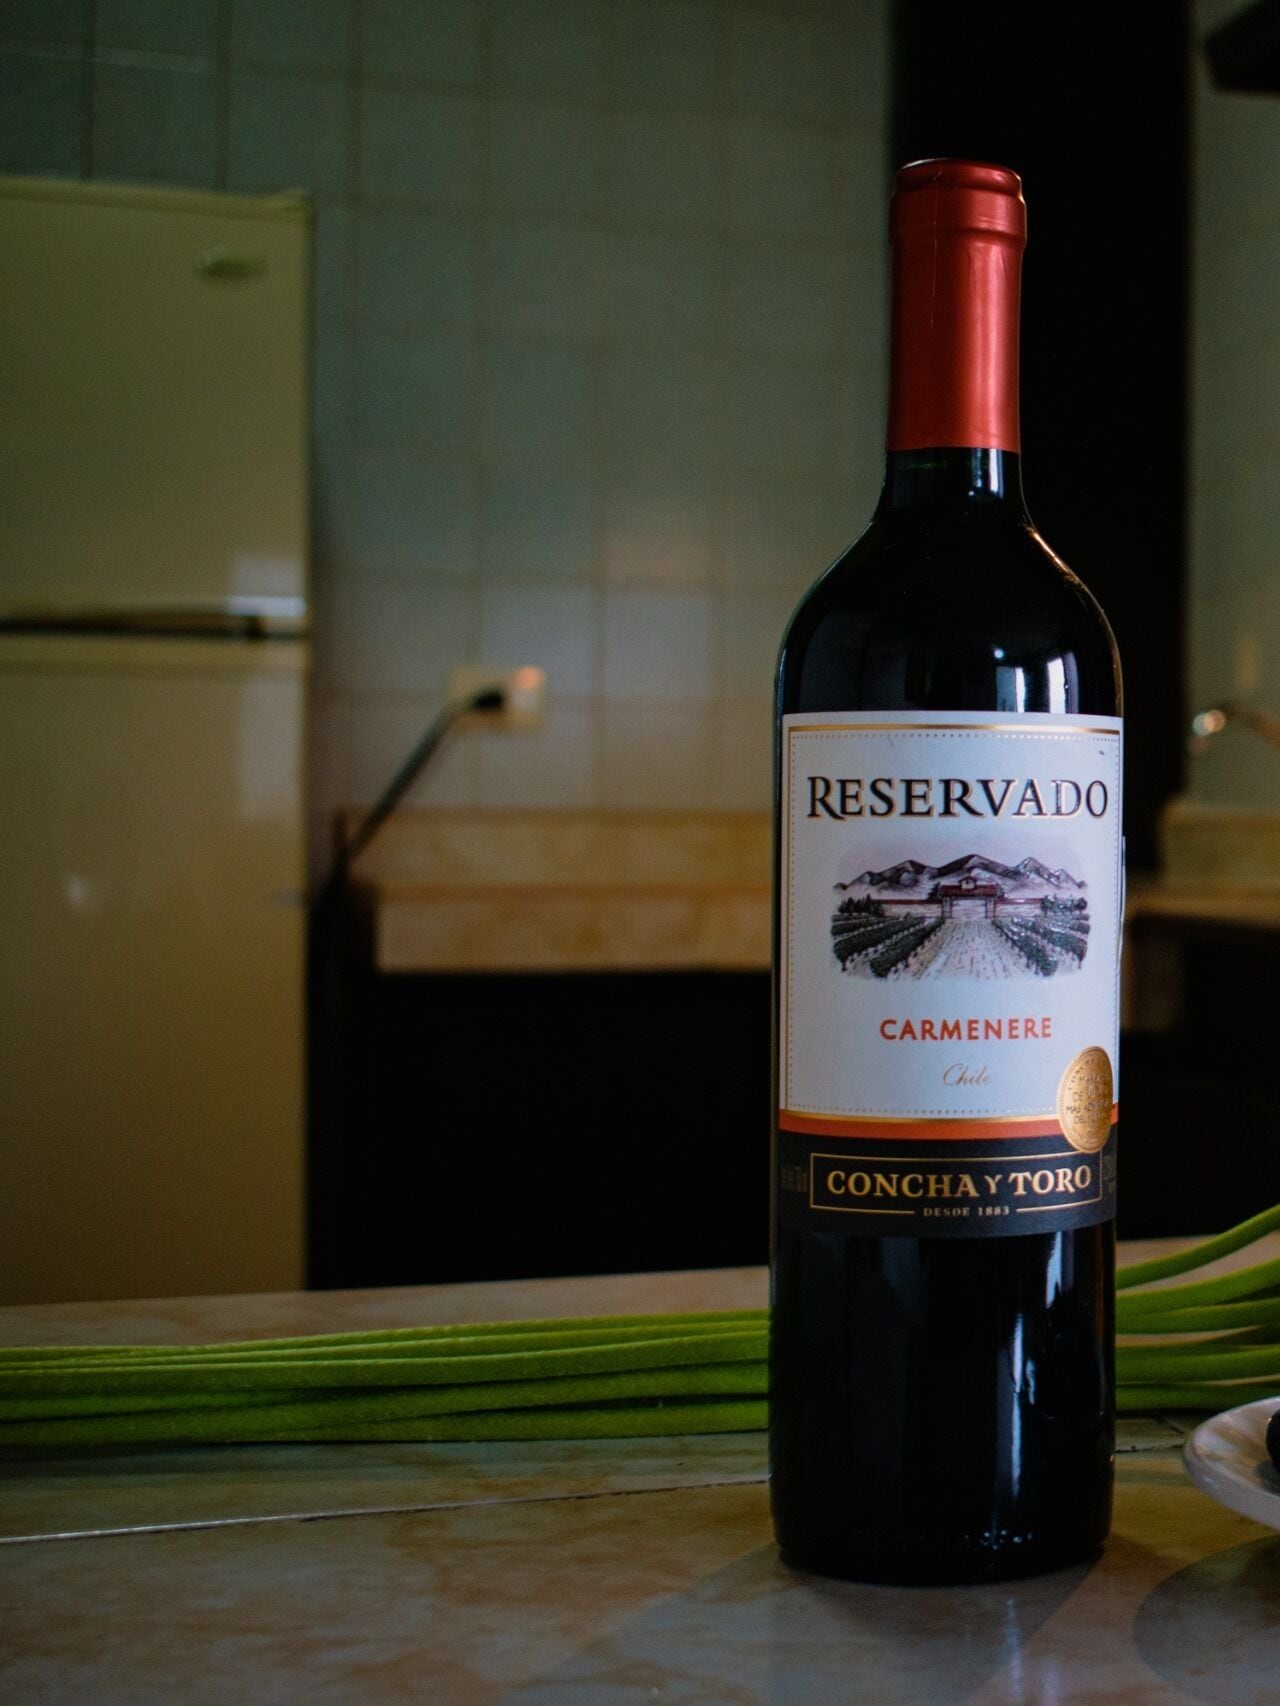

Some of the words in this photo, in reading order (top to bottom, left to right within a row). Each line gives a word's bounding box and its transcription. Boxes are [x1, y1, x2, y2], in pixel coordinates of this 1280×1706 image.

[807, 776, 1109, 821] RESERVADO
[880, 1018, 1052, 1041] CARMENERE
[942, 1063, 992, 1087] Chile
[827, 1170, 980, 1198] CONCHA
[984, 1175, 1003, 1195] Y
[1008, 1165, 1092, 1195] TORO
[923, 1206, 970, 1217] DESDE
[978, 1205, 1010, 1216] 1883
